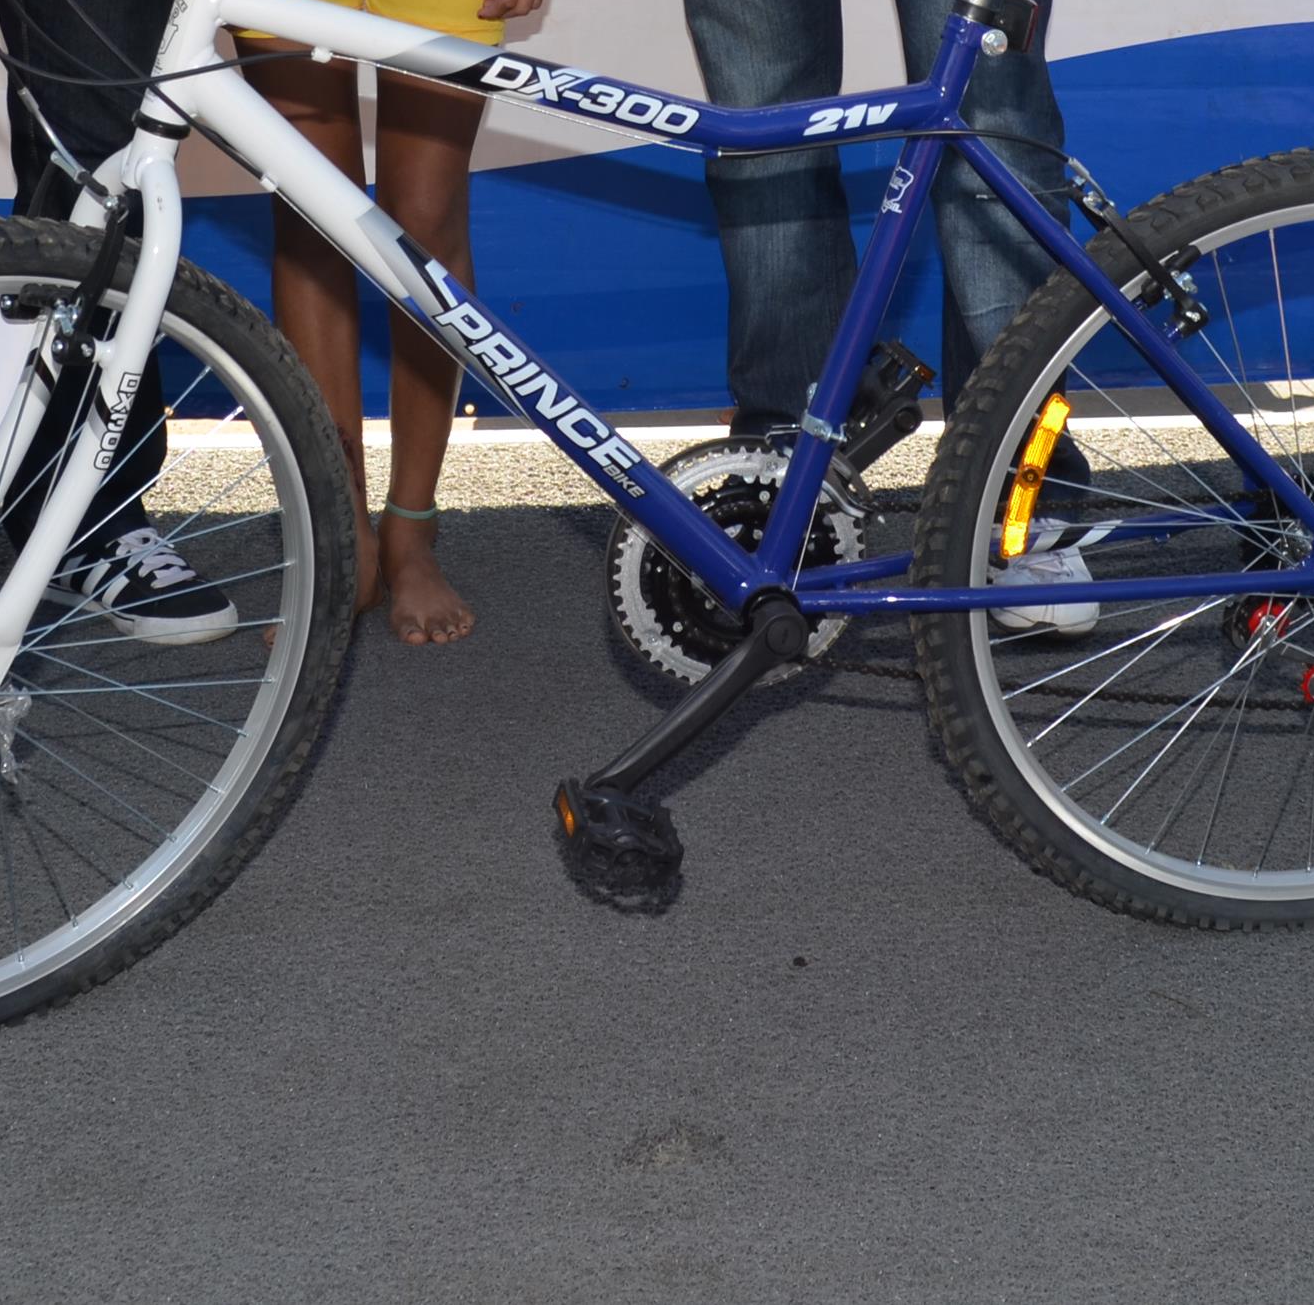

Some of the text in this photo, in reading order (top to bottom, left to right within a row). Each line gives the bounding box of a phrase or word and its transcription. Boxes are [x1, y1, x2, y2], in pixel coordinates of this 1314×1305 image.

[480, 56, 700, 135] DX-300
[435, 300, 642, 470] PRINCE
[602, 464, 646, 498] BIKE
